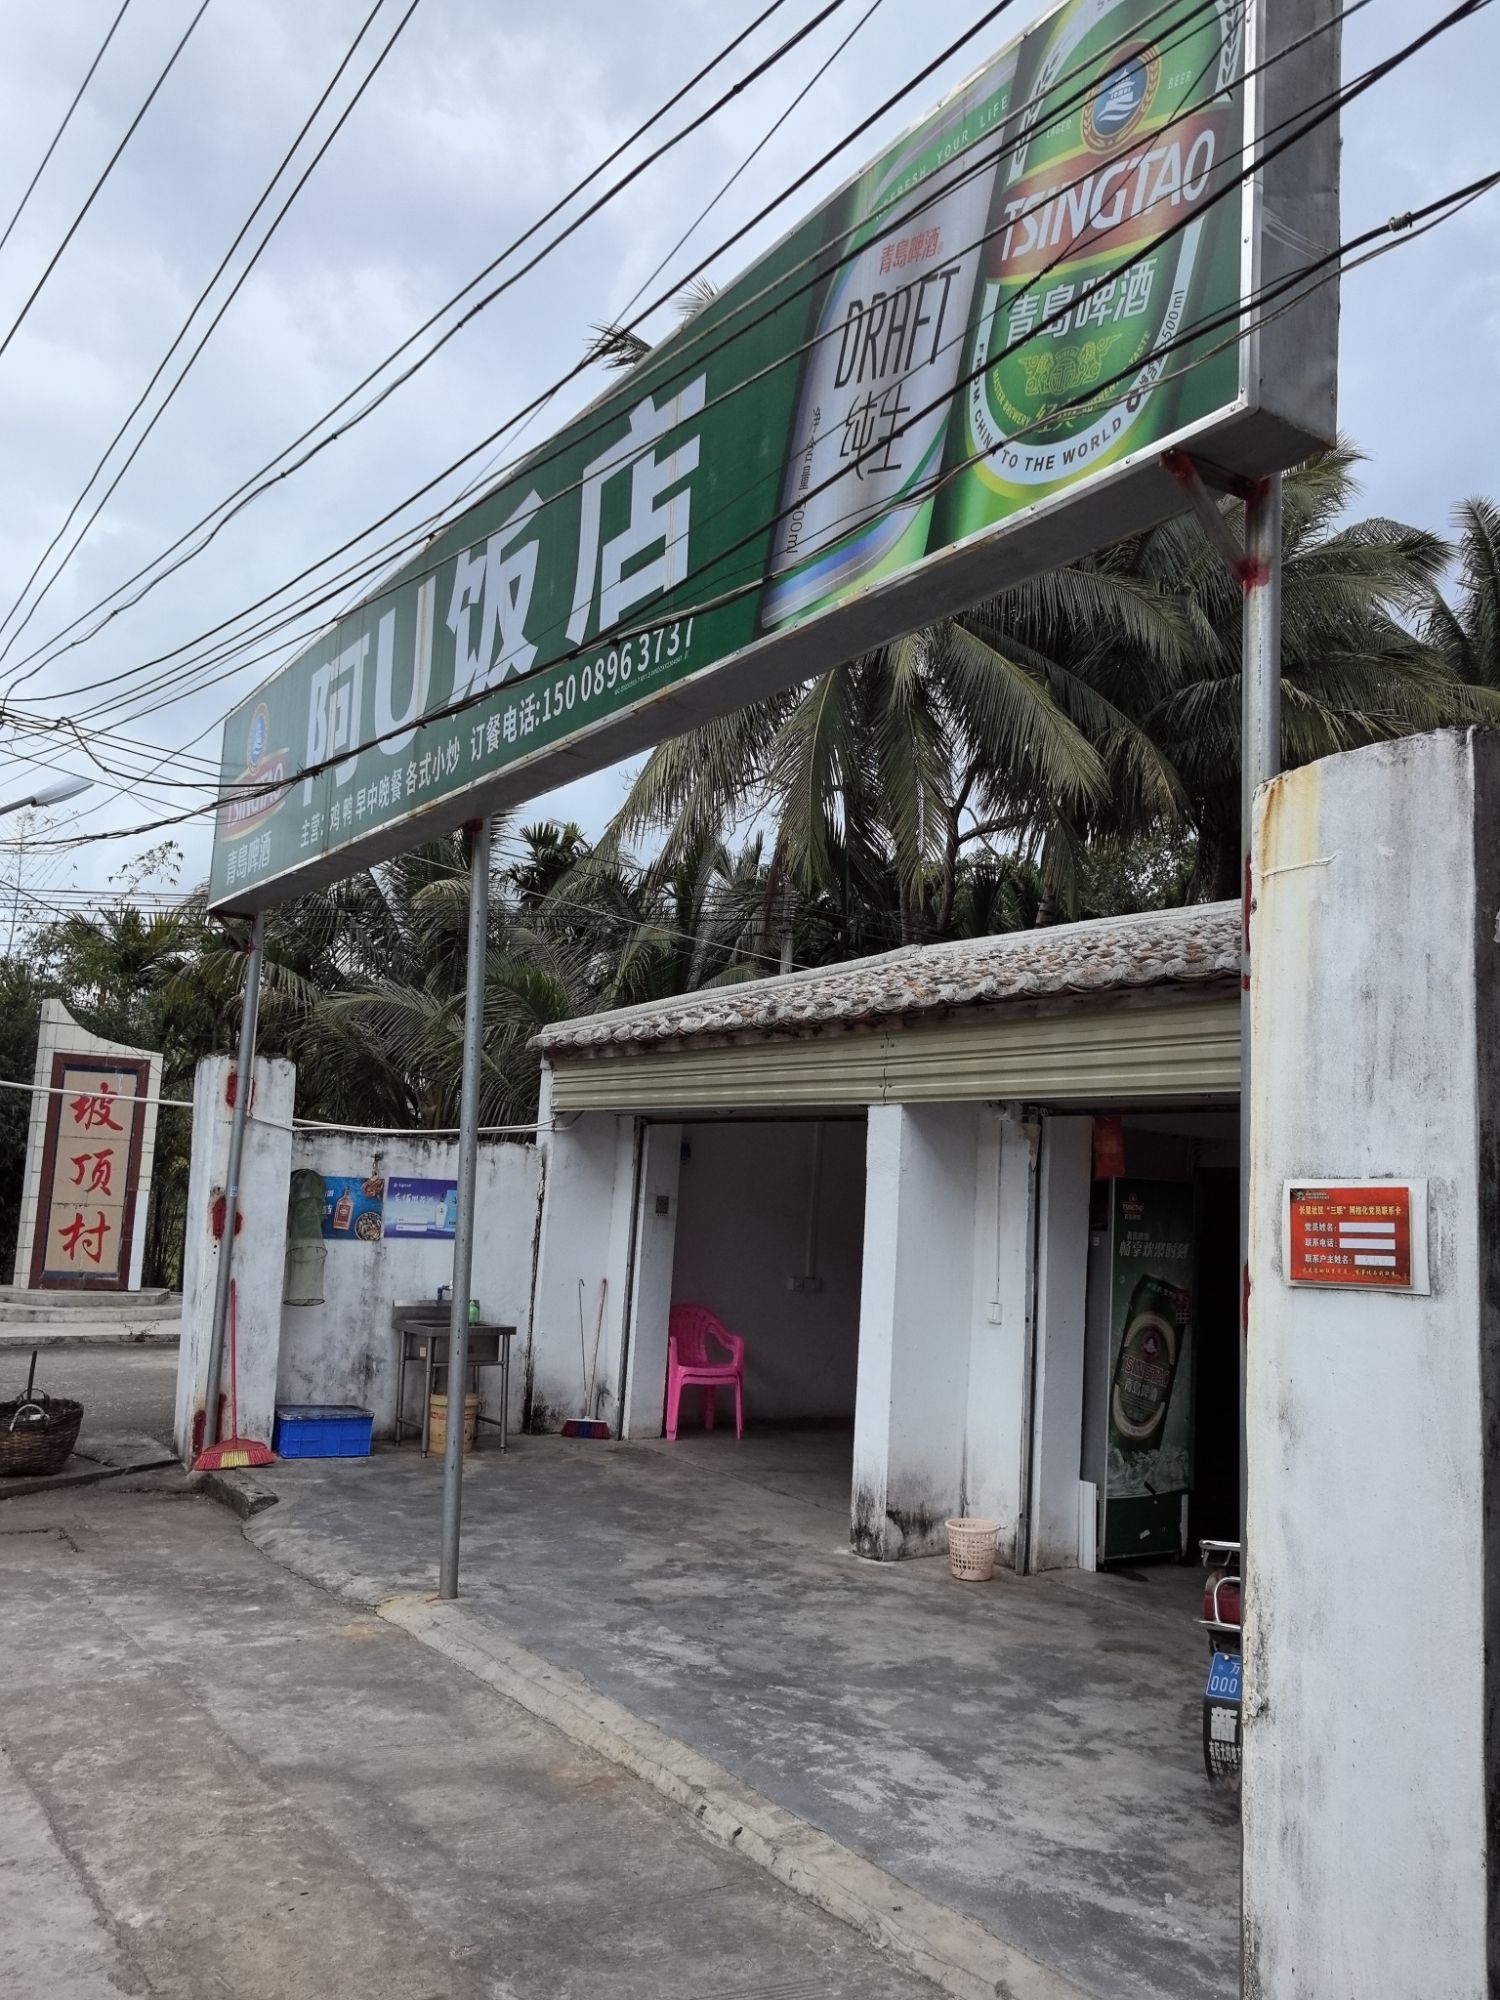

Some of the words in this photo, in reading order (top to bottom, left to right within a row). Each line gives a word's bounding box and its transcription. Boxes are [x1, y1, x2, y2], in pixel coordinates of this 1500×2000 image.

[1167, 71, 1192, 90] BEER
[937, 129, 968, 163] YOUR
[980, 95, 1008, 128] LIFE
[1002, 129, 1215, 261] TSINGTAO
[834, 265, 961, 389] DRAFT
[840, 384, 911, 480] 纯生
[1001, 449, 1018, 468] TO
[1024, 455, 1055, 472] THE
[1063, 416, 1122, 466] WORLD
[303, 372, 706, 805] 阿U饭店
